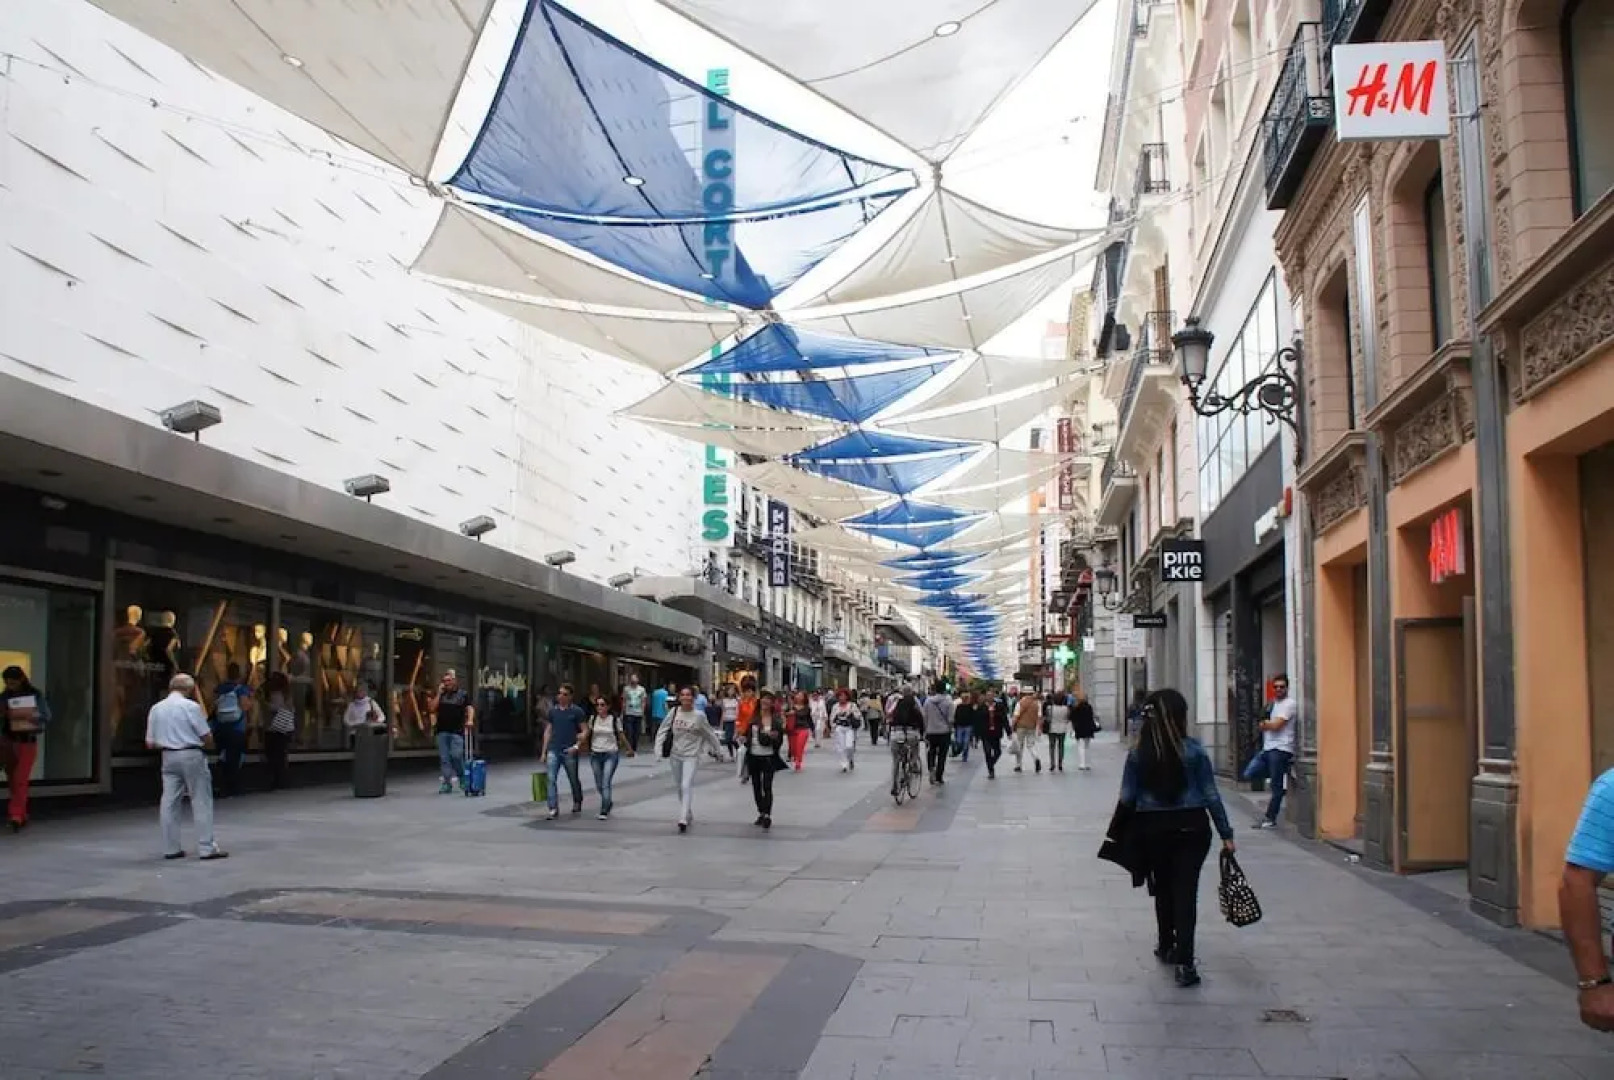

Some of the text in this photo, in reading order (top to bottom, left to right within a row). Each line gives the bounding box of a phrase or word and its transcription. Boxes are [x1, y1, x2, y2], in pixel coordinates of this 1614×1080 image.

[706, 69, 730, 131] EL
[1346, 60, 1437, 117] H&M
[772, 509, 785, 584] SPORT
[1163, 551, 1202, 569] pim
